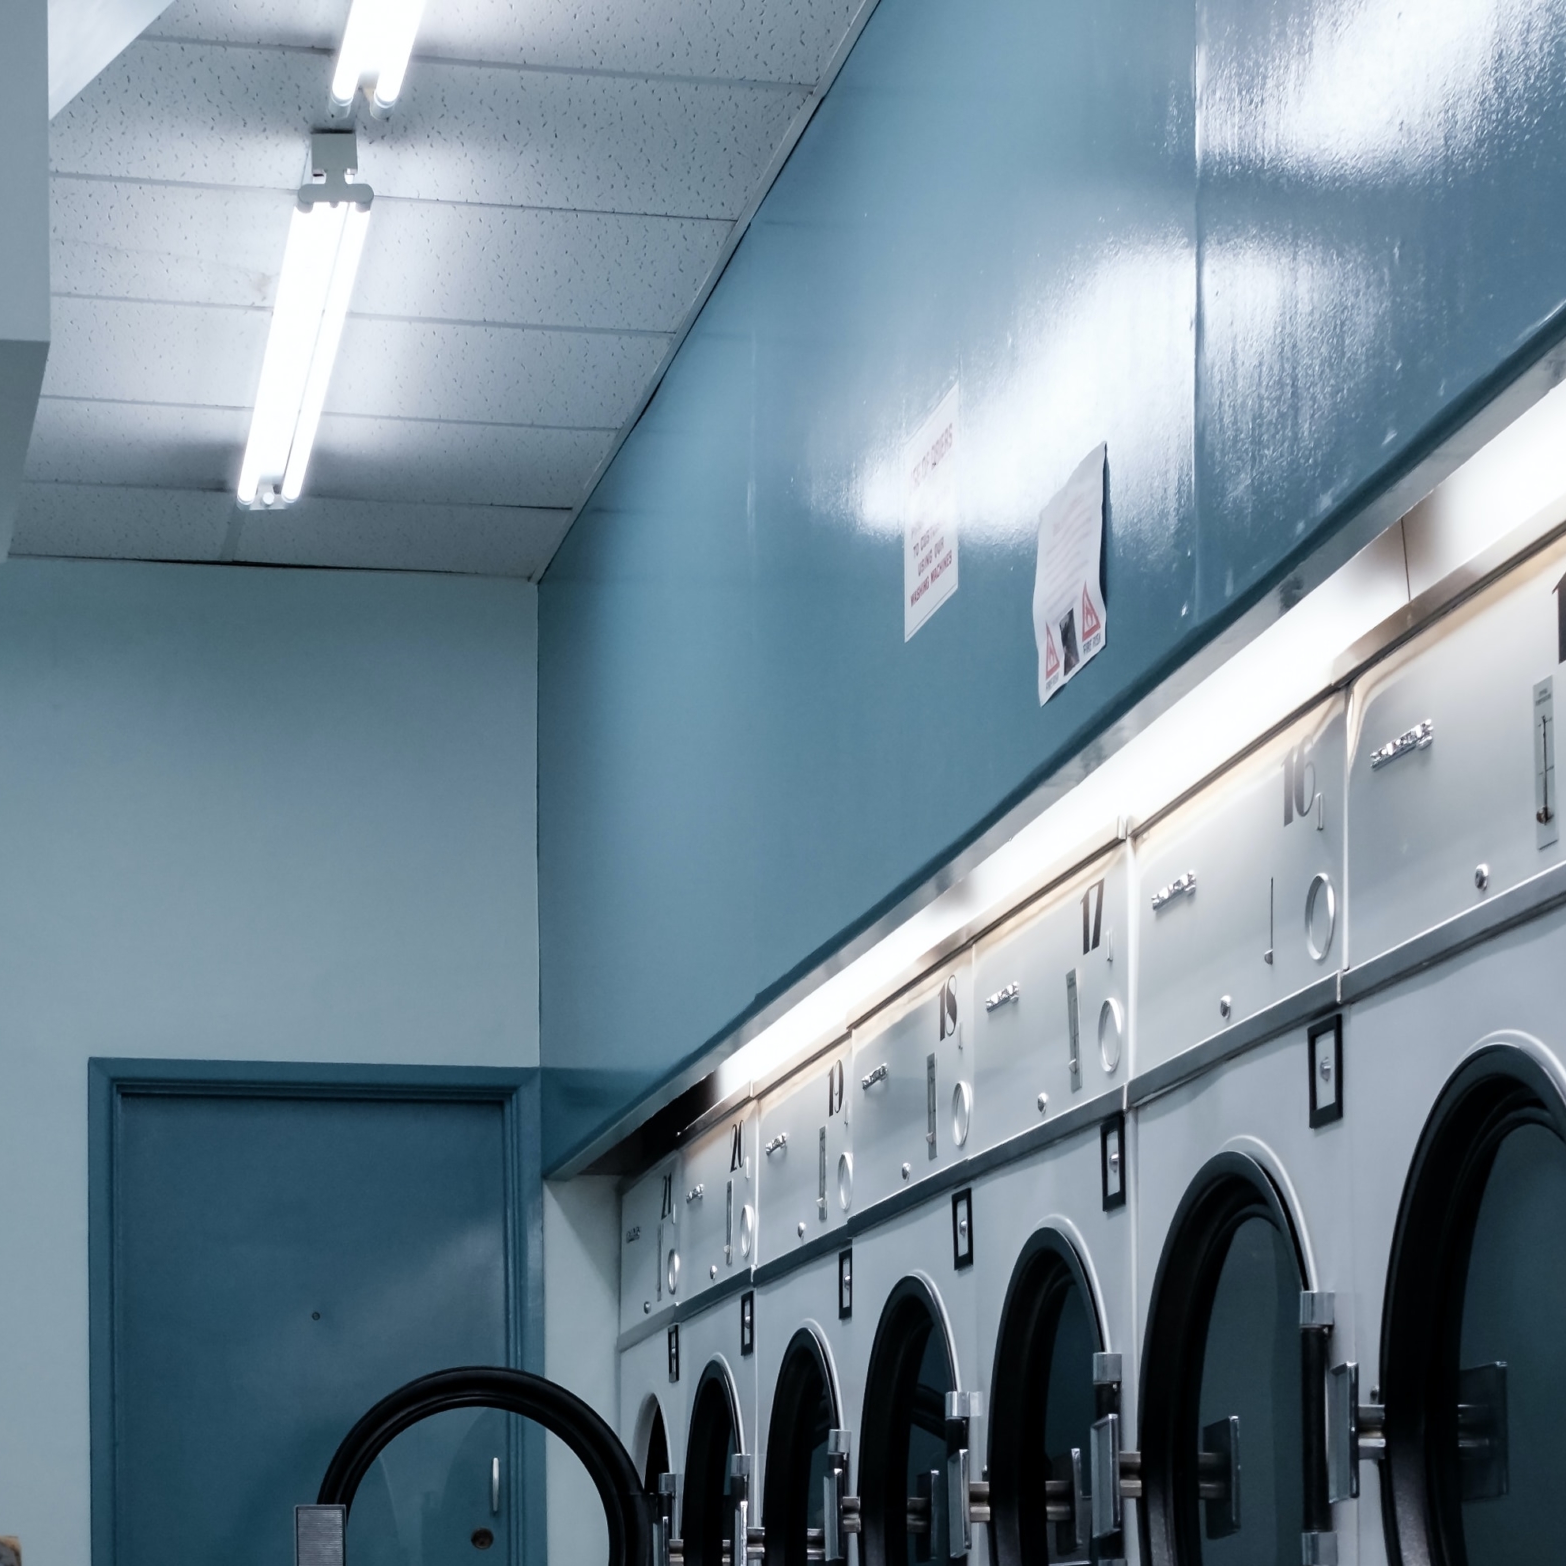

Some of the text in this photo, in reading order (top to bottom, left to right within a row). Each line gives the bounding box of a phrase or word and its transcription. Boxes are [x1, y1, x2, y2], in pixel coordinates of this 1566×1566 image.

[1281, 735, 1316, 827] 16
[1080, 877, 1105, 955] 17
[938, 974, 958, 1042] 18
[828, 1059, 844, 1118] 19
[730, 1119, 746, 1173] 20
[661, 1172, 672, 1220] 21
